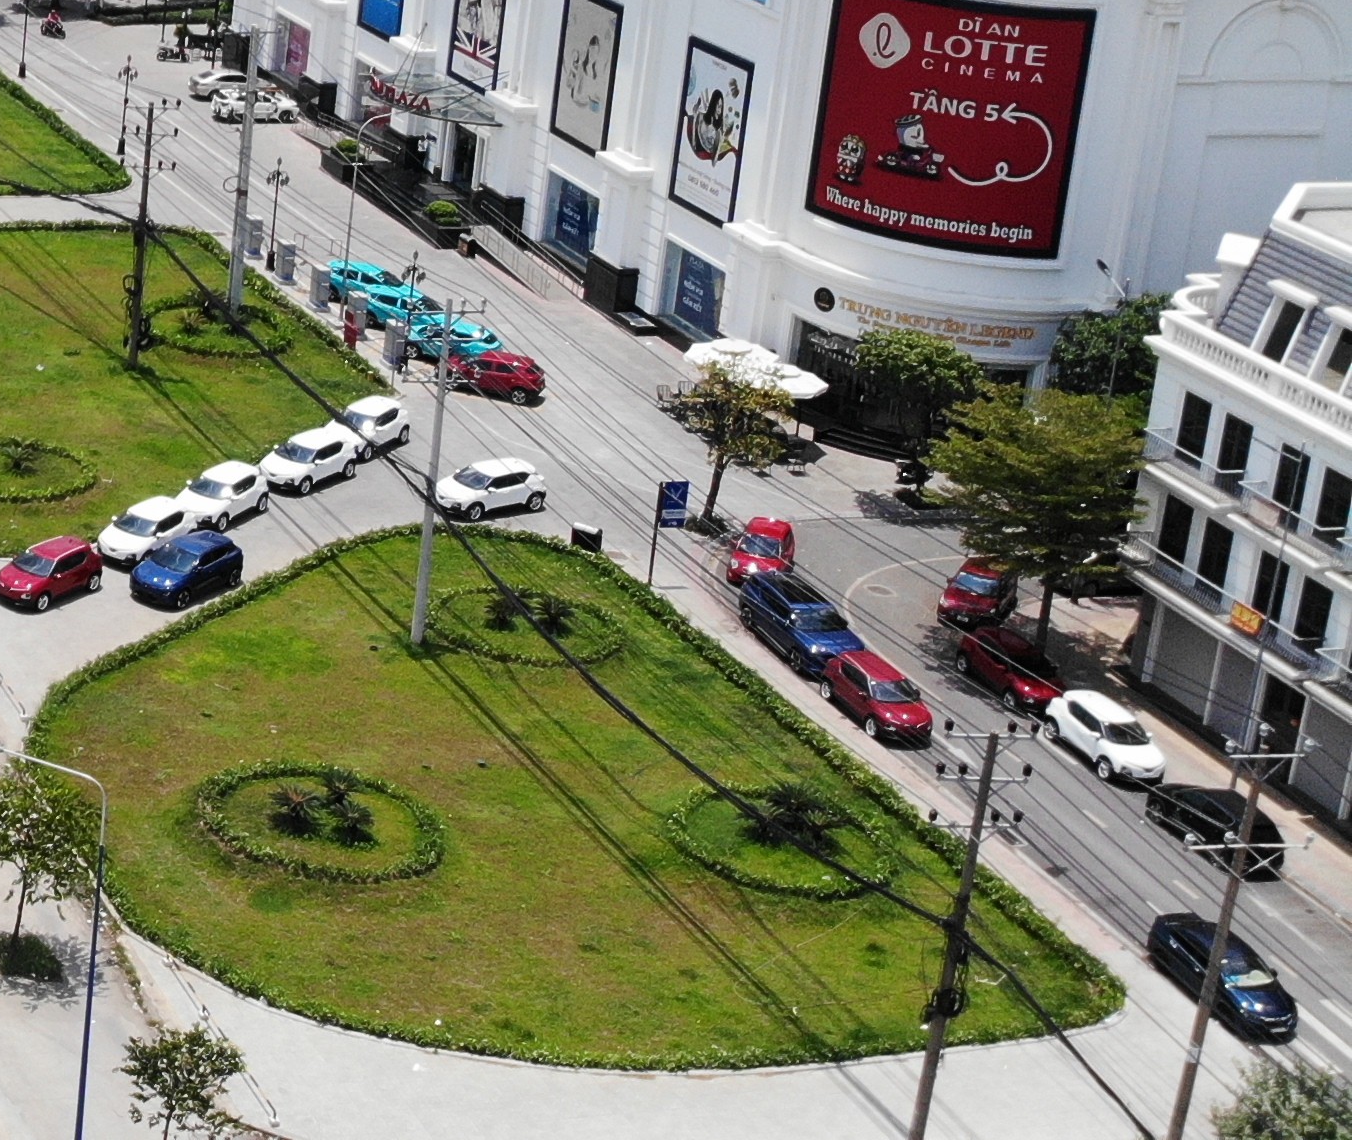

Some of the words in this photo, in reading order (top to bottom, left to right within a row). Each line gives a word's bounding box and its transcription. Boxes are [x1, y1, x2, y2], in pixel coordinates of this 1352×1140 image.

[959, 17, 983, 33] DĨ
[987, 23, 1020, 38] AN
[924, 31, 1048, 67] LOTTE
[921, 57, 1043, 83] CINEMA
[909, 88, 976, 119] TẦNG
[984, 104, 999, 121] 5
[826, 186, 861, 211] Where
[863, 199, 908, 226] happy
[911, 213, 986, 236] memories
[990, 222, 1033, 242] begin
[839, 297, 892, 321] TRUNG
[970, 324, 1036, 340] LEGEND
